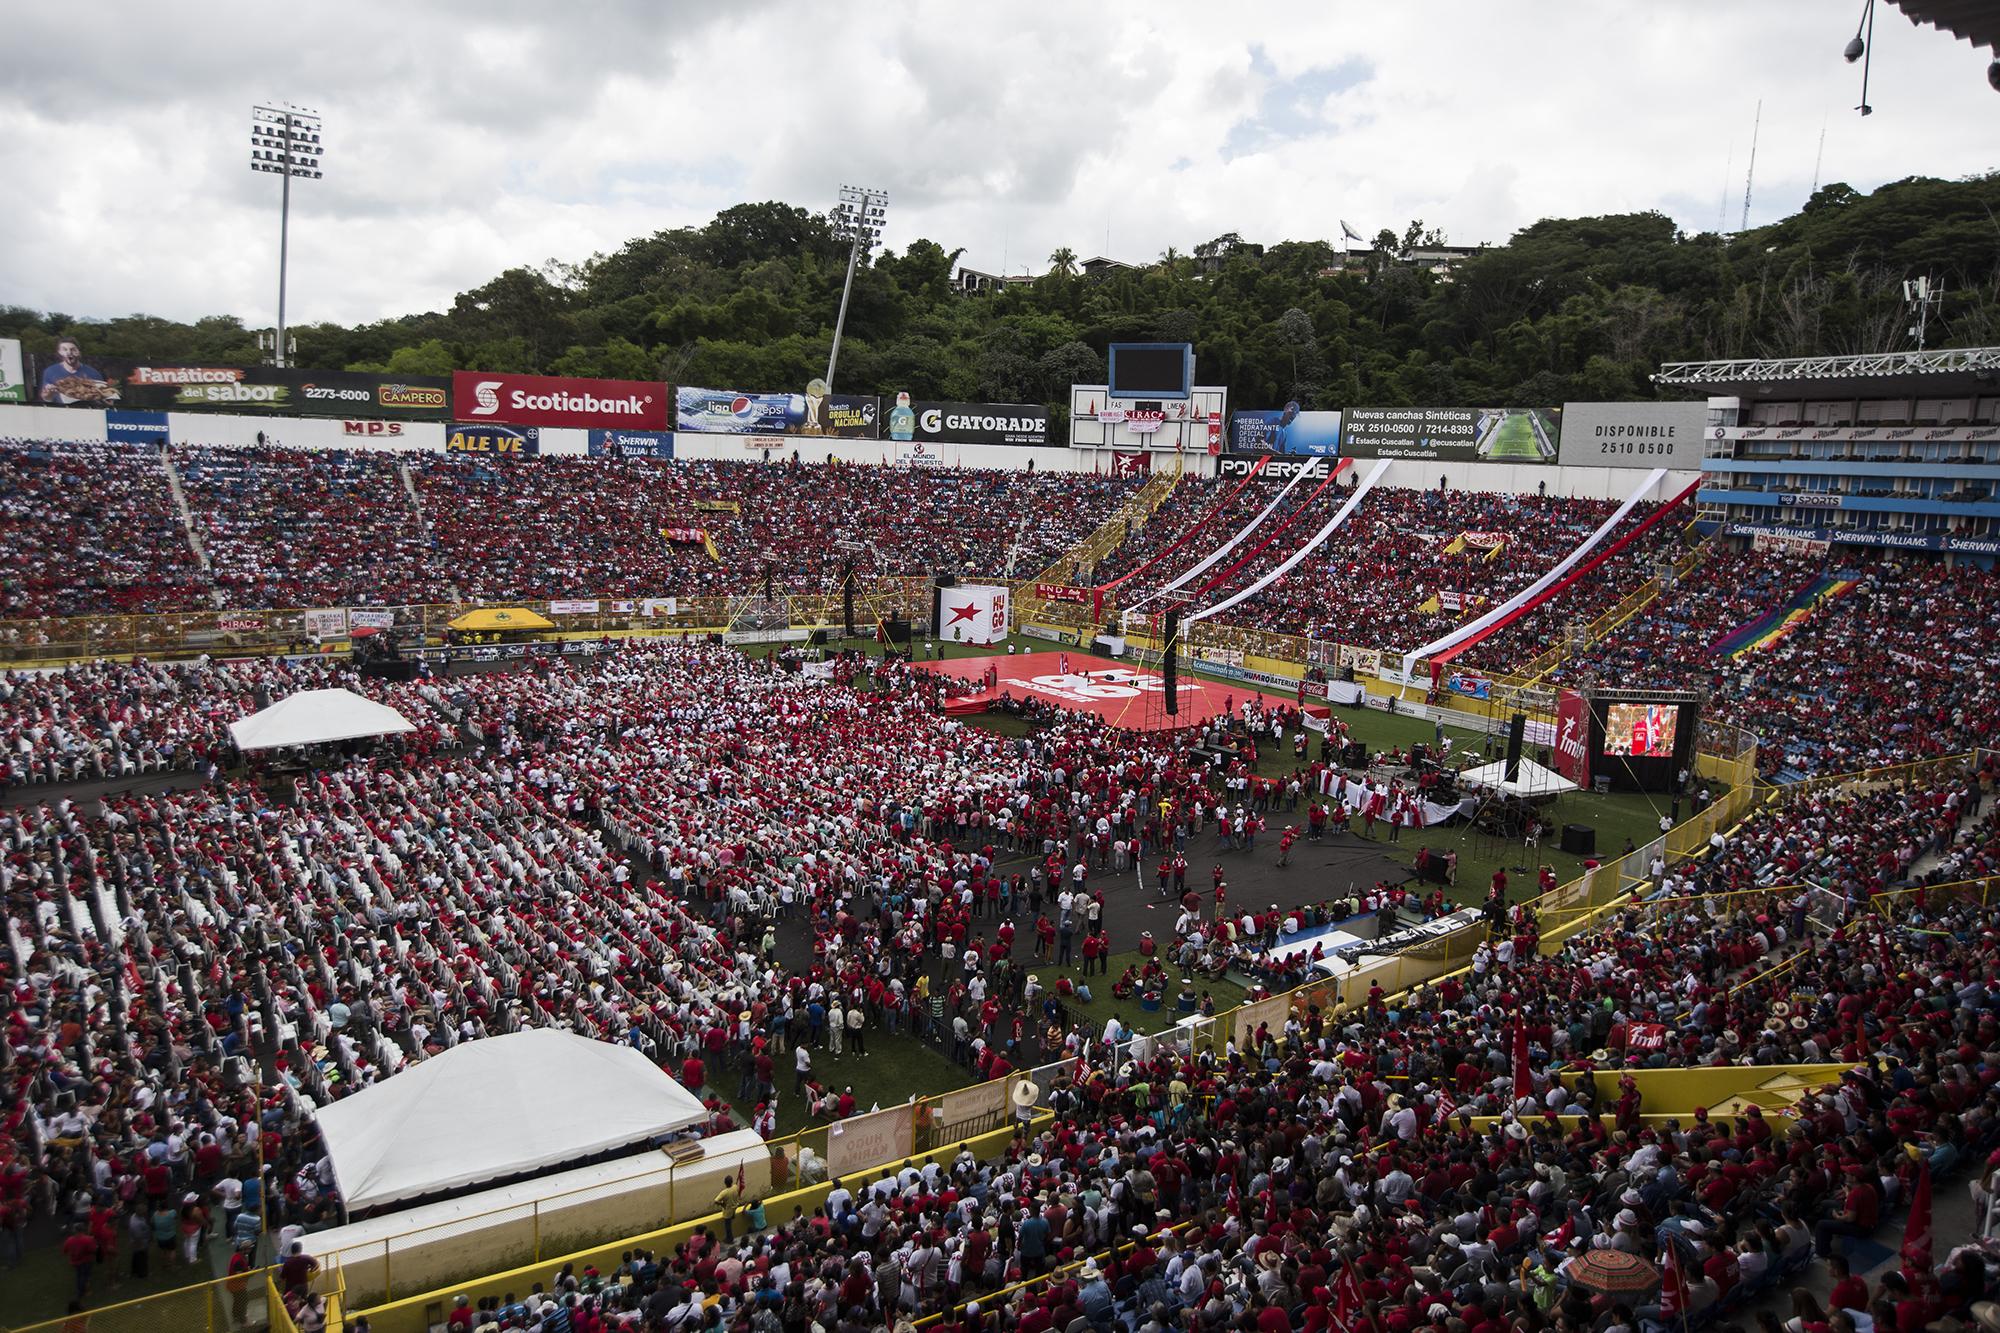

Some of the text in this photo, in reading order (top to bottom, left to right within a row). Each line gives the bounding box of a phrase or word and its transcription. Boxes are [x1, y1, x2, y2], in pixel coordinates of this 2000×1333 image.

[138, 367, 237, 383] Fanáticos
[184, 382, 279, 401] del sabor
[306, 388, 370, 402] 2273-6000
[382, 391, 443, 404] CAMPERO
[511, 390, 644, 415] Scotiabank
[708, 400, 731, 412] liga
[755, 403, 785, 415] pepsi
[829, 410, 861, 419] ORGULLO
[1124, 410, 1159, 419] CIRAC
[1352, 410, 1471, 420] Nuevas canchas Sintéticas
[108, 423, 169, 433] TOYO TIRES
[344, 421, 402, 435] MPS
[834, 417, 867, 427] NACIONAL
[946, 415, 1046, 433] GATORADE
[1347, 423, 1474, 434] PBX 2510-0500 / 7214-8393
[1595, 425, 1675, 437] DISPONIBLE
[447, 432, 490, 451] ALE
[1355, 437, 1380, 445] Estadio
[1377, 448, 1402, 456] Estadio
[1601, 442, 1673, 454] 2510 0500
[1798, 496, 1839, 506] SPORTS
[1732, 524, 1816, 539] SHERWIN-WILLIAMS
[1833, 531, 1928, 547] SHERWIN-WILLIAMS
[993, 594, 1005, 612] HU
[992, 612, 1005, 629] GO
[1243, 671, 1299, 689] HUMRO BATERIAS
[1631, 1030, 1663, 1047] fmln
